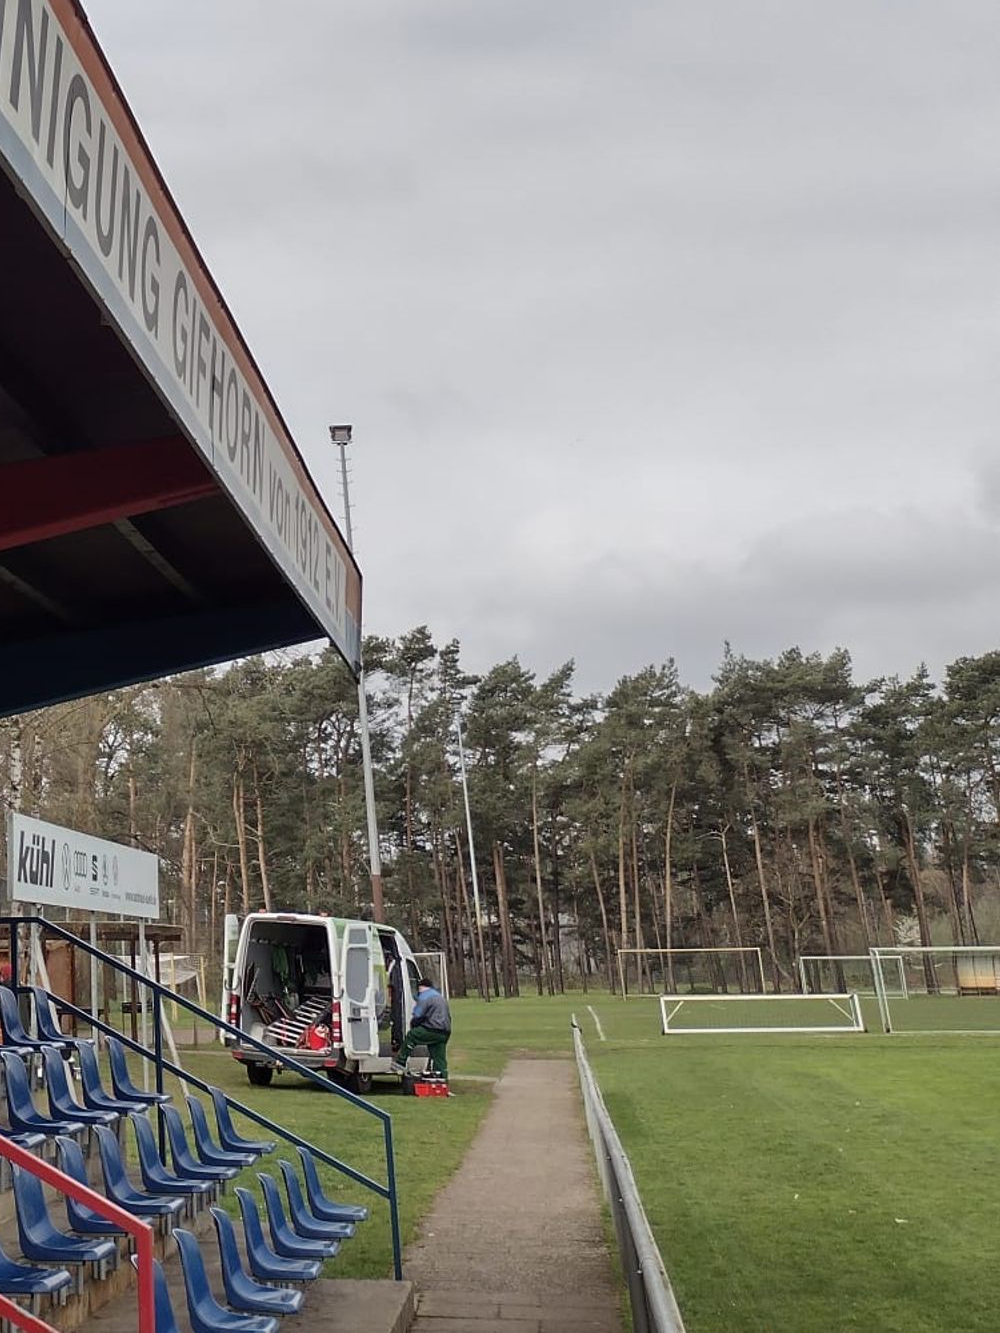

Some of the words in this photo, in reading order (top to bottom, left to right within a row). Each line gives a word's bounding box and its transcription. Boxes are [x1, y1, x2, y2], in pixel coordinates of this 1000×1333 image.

[172, 269, 266, 505] GIFHORN
[269, 461, 291, 550] von
[294, 492, 320, 595] 1912
[17, 830, 56, 888] kühl
